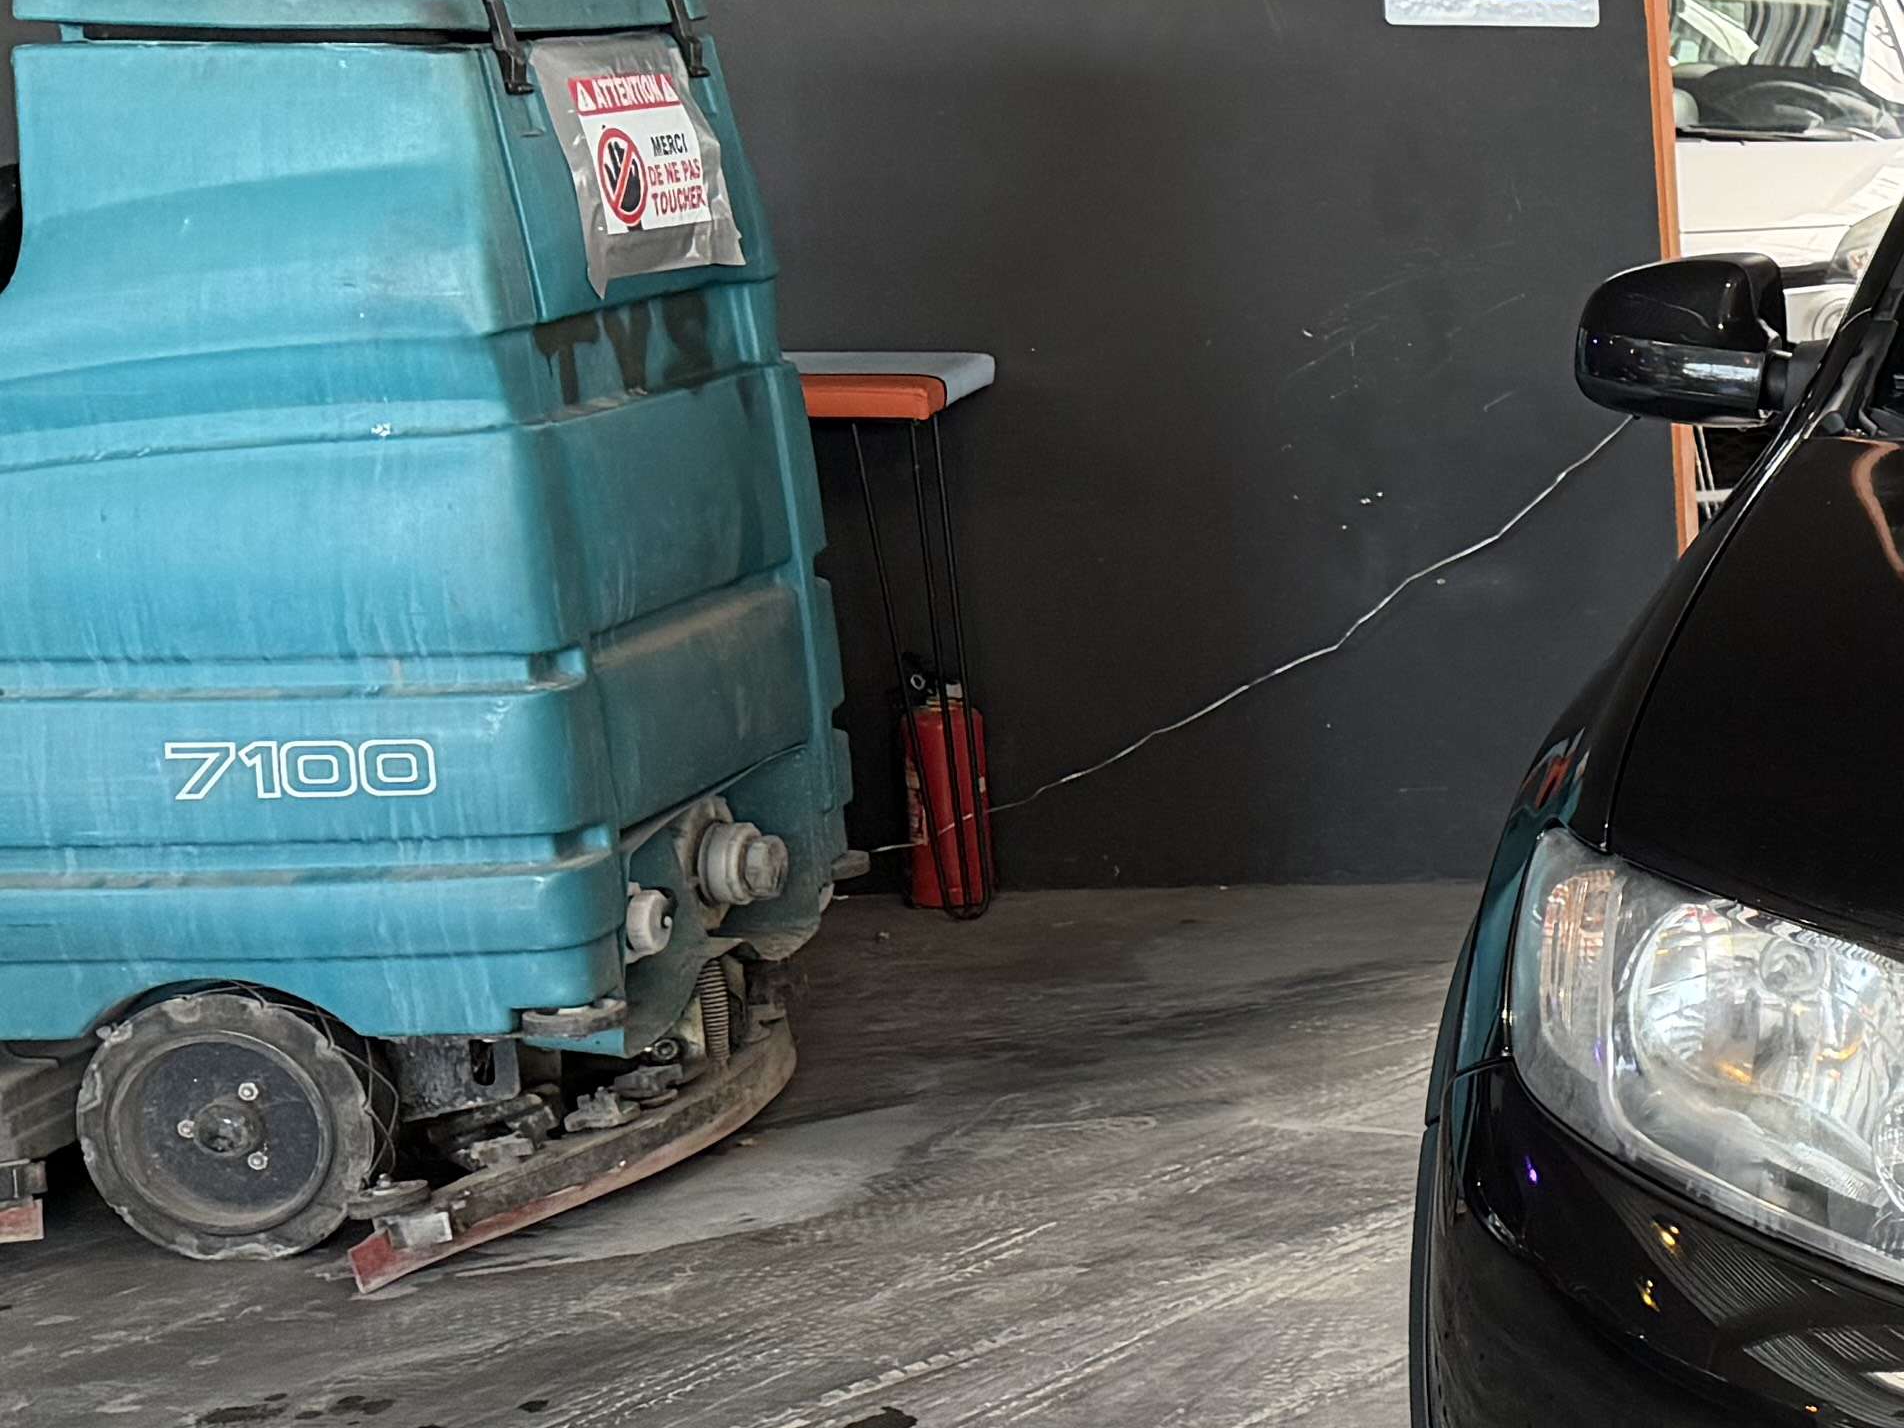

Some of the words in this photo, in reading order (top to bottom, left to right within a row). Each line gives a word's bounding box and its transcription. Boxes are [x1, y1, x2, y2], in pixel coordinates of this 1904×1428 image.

[593, 75, 662, 108] ATTENTION
[651, 133, 688, 157] MERCI
[648, 163, 664, 186] DE
[666, 160, 682, 184] NE
[683, 158, 700, 181] PAS
[651, 185, 707, 216] TOUCHER
[164, 738, 437, 800] 7100
